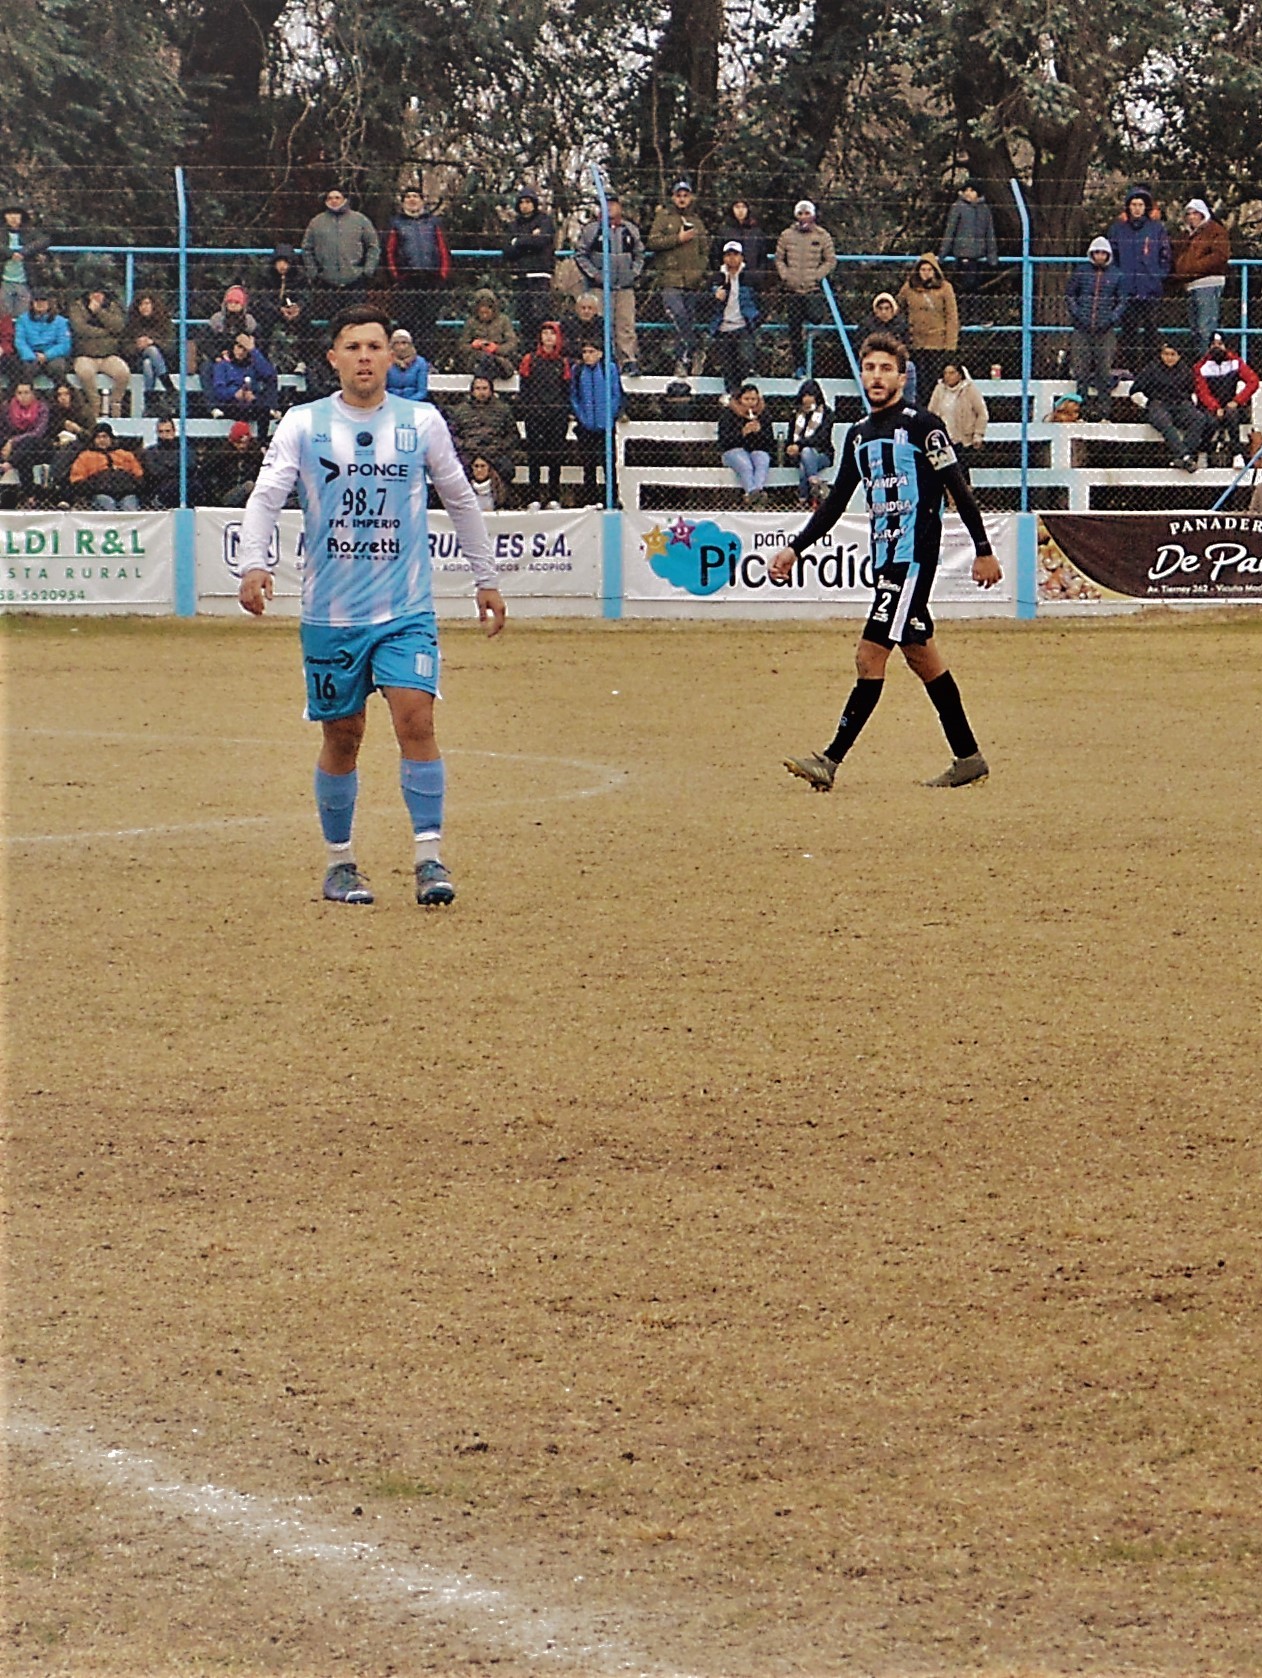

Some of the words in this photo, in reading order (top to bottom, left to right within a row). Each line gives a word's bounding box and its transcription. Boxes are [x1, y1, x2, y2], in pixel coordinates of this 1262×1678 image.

[347, 463, 409, 477] PONCE
[341, 487, 387, 516] 98.7
[352, 518, 401, 529] IMPERIO
[75, 529, 146, 554] R&L
[327, 537, 400, 554] Rossetti
[532, 532, 572, 557] S.A.
[65, 567, 142, 579] RURAL
[1148, 544, 1201, 580] De
[877, 592, 893, 613] 2
[312, 672, 337, 700] 16
